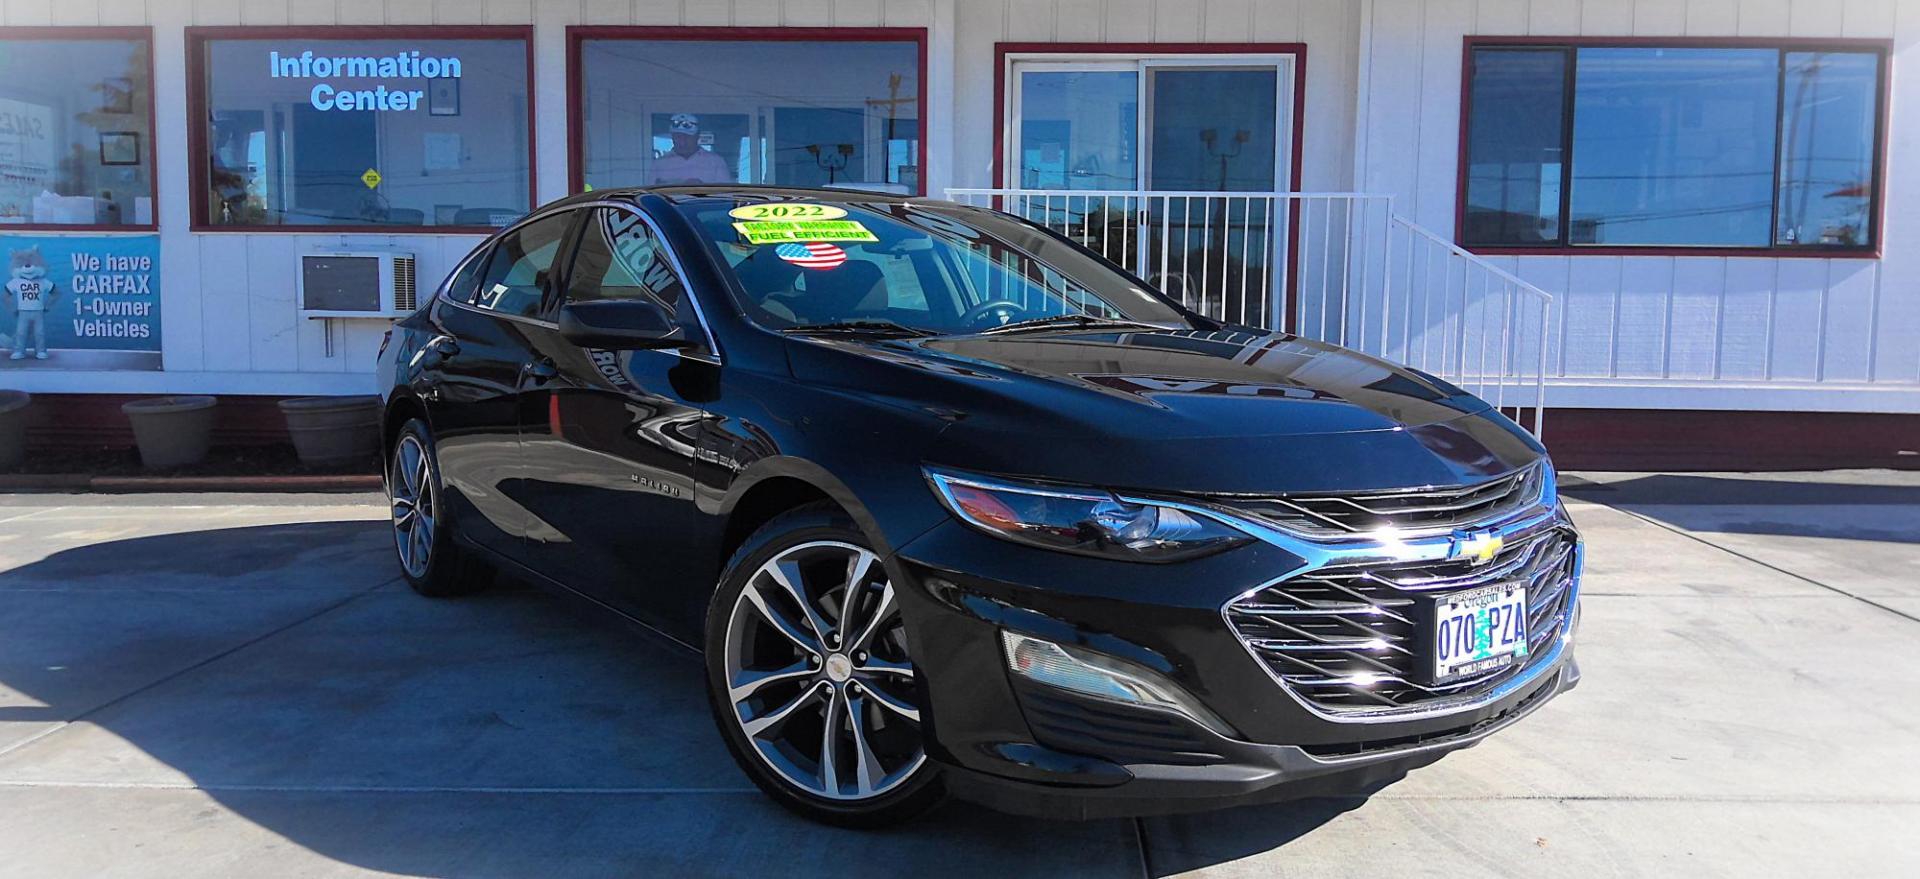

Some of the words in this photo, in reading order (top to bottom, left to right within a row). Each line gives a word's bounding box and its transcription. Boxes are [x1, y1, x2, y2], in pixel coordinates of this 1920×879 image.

[270, 51, 462, 78] Information
[310, 84, 424, 111] Center
[753, 206, 825, 218] 2022
[749, 231, 790, 241] FUEL
[792, 231, 870, 239] EFFICIENT
[71, 253, 100, 271] We
[106, 253, 151, 271] have
[20, 283, 40, 291] CAR
[72, 275, 151, 294] CARFAX
[22, 292, 40, 301] FOX
[73, 298, 152, 316] 1-Owner
[73, 319, 150, 338] Vehicles
[1464, 592, 1499, 608] Oregon
[1438, 613, 1476, 661] 070
[1488, 602, 1526, 648] PZA
[1458, 661, 1477, 676] WORLD
[1477, 657, 1499, 672] FAMOUS
[1499, 653, 1512, 668] AUTO
